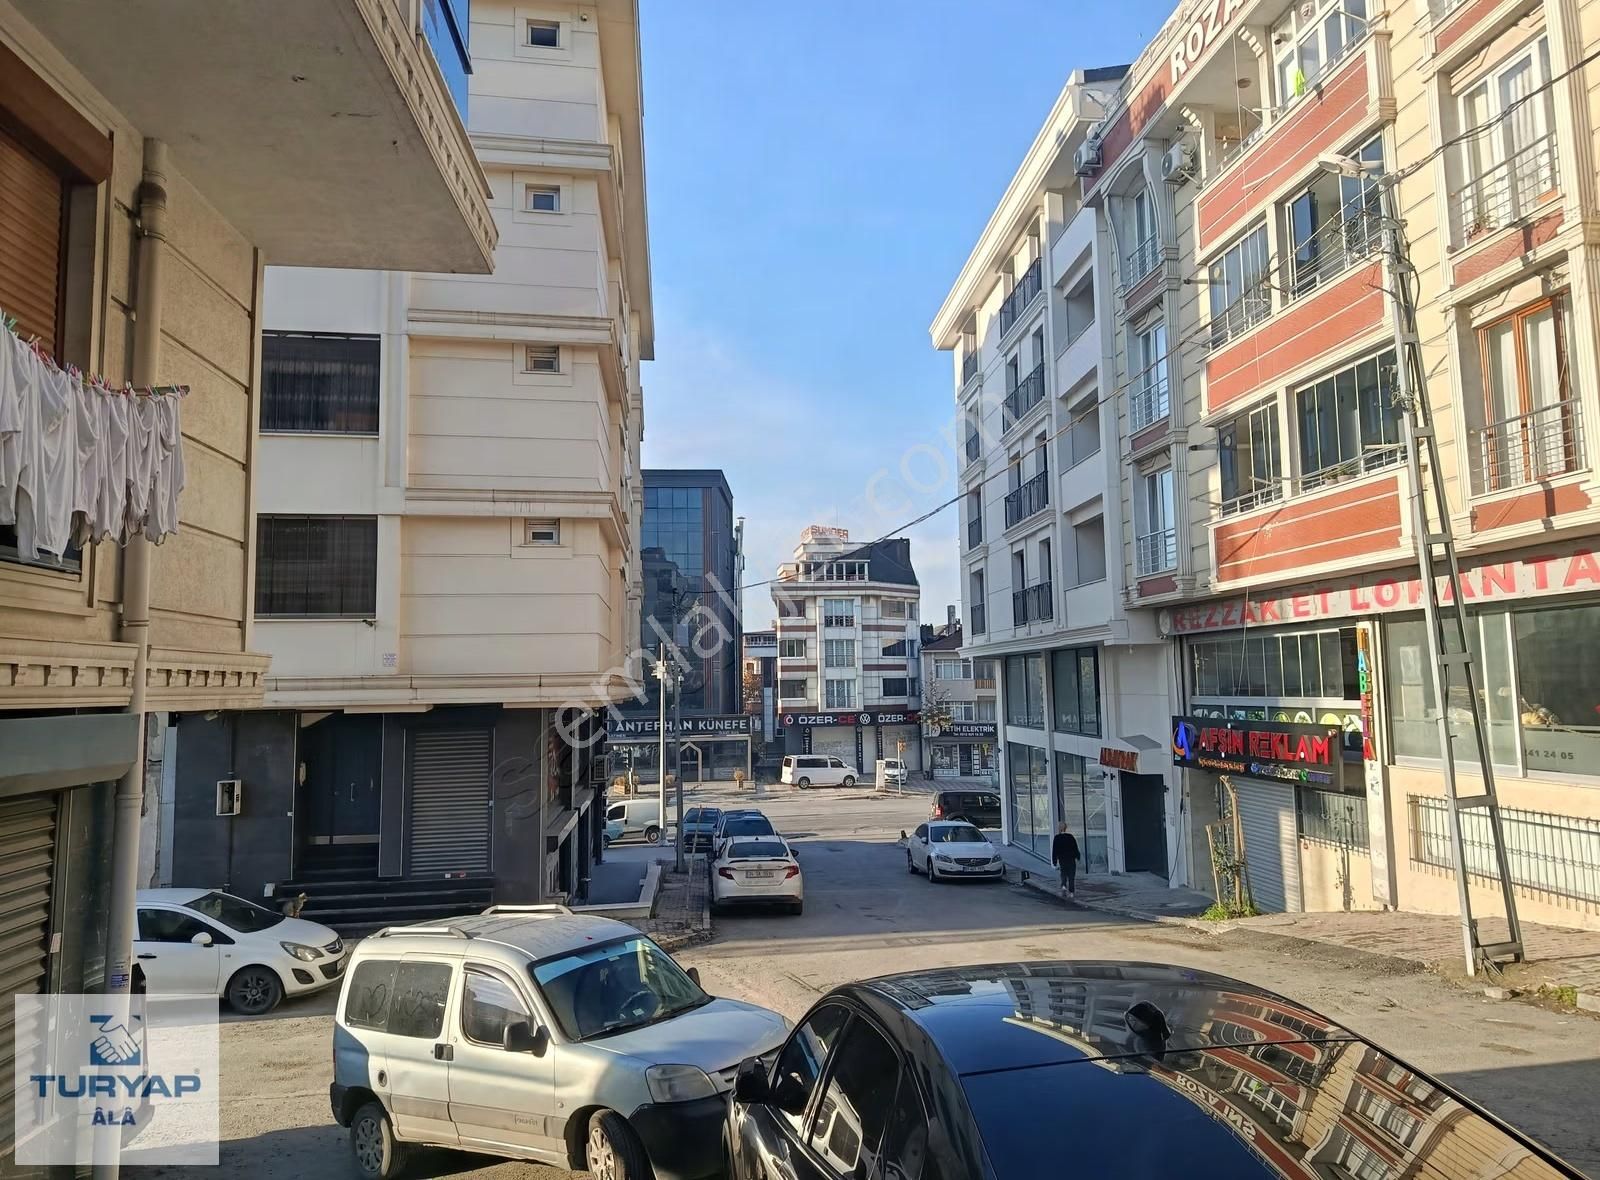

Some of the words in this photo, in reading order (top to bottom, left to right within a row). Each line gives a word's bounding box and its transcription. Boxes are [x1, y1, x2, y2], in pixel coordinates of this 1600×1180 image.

[1173, 596, 1281, 632] REZZAK
[1292, 586, 1333, 618] ET
[699, 719, 747, 730] KÜNEFE
[962, 724, 995, 733] ELEKTRİK
[1249, 730, 1330, 765] REKLAM
[1560, 751, 1574, 760] 05
